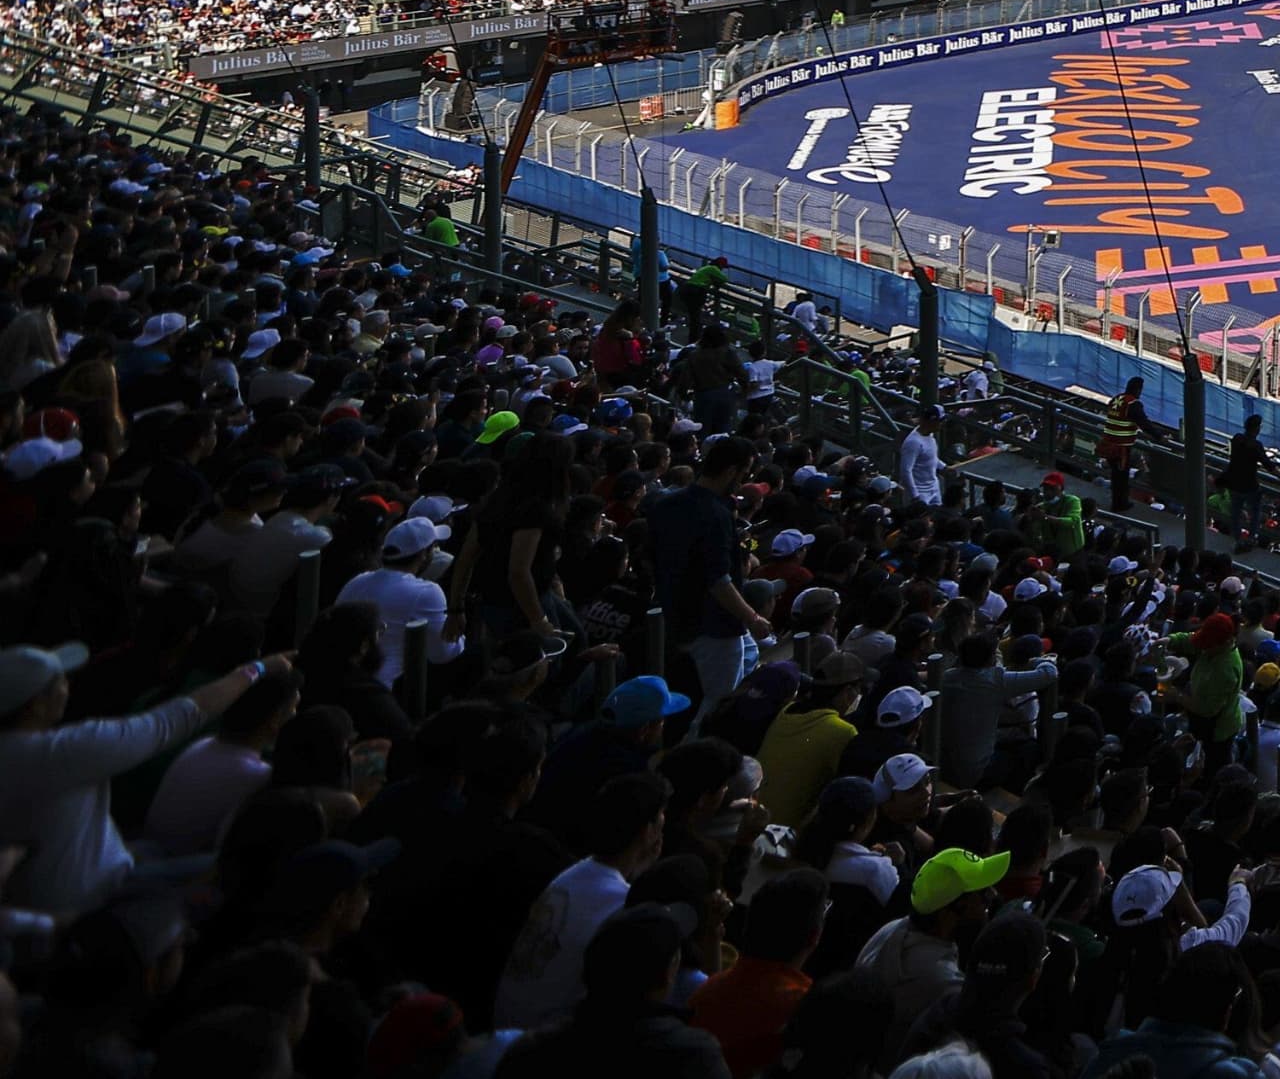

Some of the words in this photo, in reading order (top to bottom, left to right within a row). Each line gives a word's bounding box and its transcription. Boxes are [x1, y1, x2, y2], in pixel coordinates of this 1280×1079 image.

[1130, 8, 1161, 22] Julius
[1161, 4, 1182, 15] Bär
[1186, 0, 1216, 13] Julius
[470, 22, 511, 37] Julius
[514, 18, 539, 29] Bär
[1008, 27, 1044, 42] Julius
[1046, 22, 1068, 34] Bär
[1071, 17, 1106, 32] Julius
[1106, 13, 1127, 24] Bär
[344, 38, 390, 55] Julius
[394, 34, 421, 46] Bär
[944, 38, 980, 53] Julius
[981, 32, 1004, 45] Bär
[212, 54, 262, 73] Julius
[266, 51, 296, 63] Bär
[878, 49, 915, 65] Julius
[917, 43, 940, 56] Bär
[814, 62, 848, 79] Julius
[850, 55, 873, 68] Bär
[765, 76, 791, 92] Julius
[792, 69, 811, 82] Bär
[1039, 54, 1202, 152] MEXICO
[959, 86, 1057, 199] ELECTRIC
[1006, 159, 1245, 240] CITY
